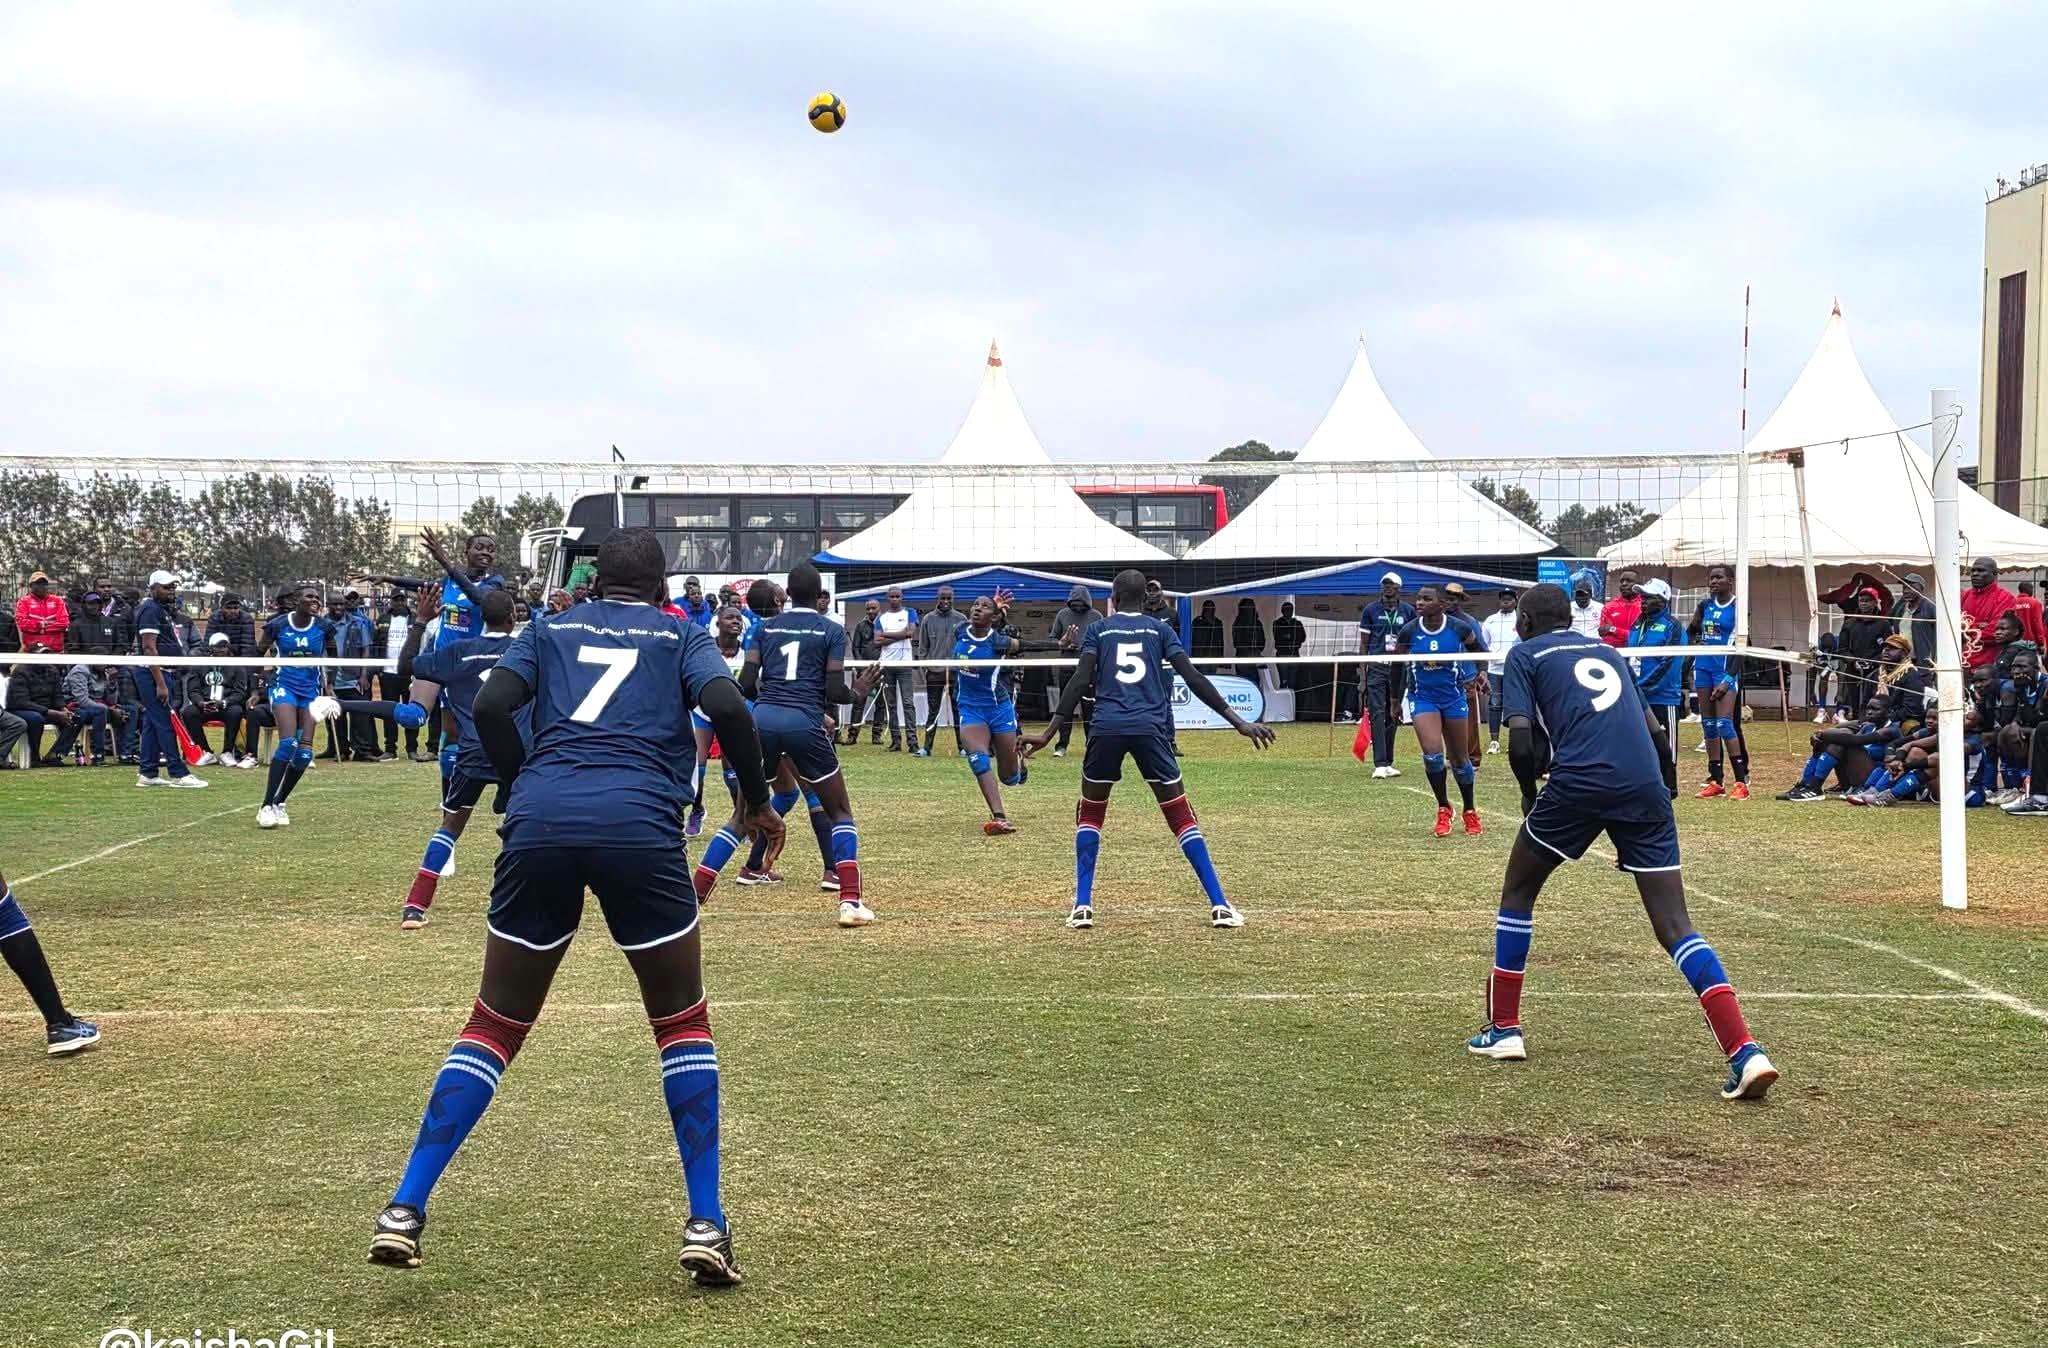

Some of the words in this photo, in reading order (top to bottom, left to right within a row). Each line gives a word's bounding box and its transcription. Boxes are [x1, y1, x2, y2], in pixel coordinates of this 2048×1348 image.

[628, 628, 648, 636] TEAM
[295, 636, 308, 647] 14
[1430, 640, 1438, 651] 8
[967, 644, 977, 654] 7
[780, 641, 800, 680] 1
[1115, 642, 1146, 684] 5
[569, 645, 639, 723] 7
[1574, 657, 1622, 712] 9
[273, 687, 286, 699] 14
[1228, 693, 1251, 703] NO!
